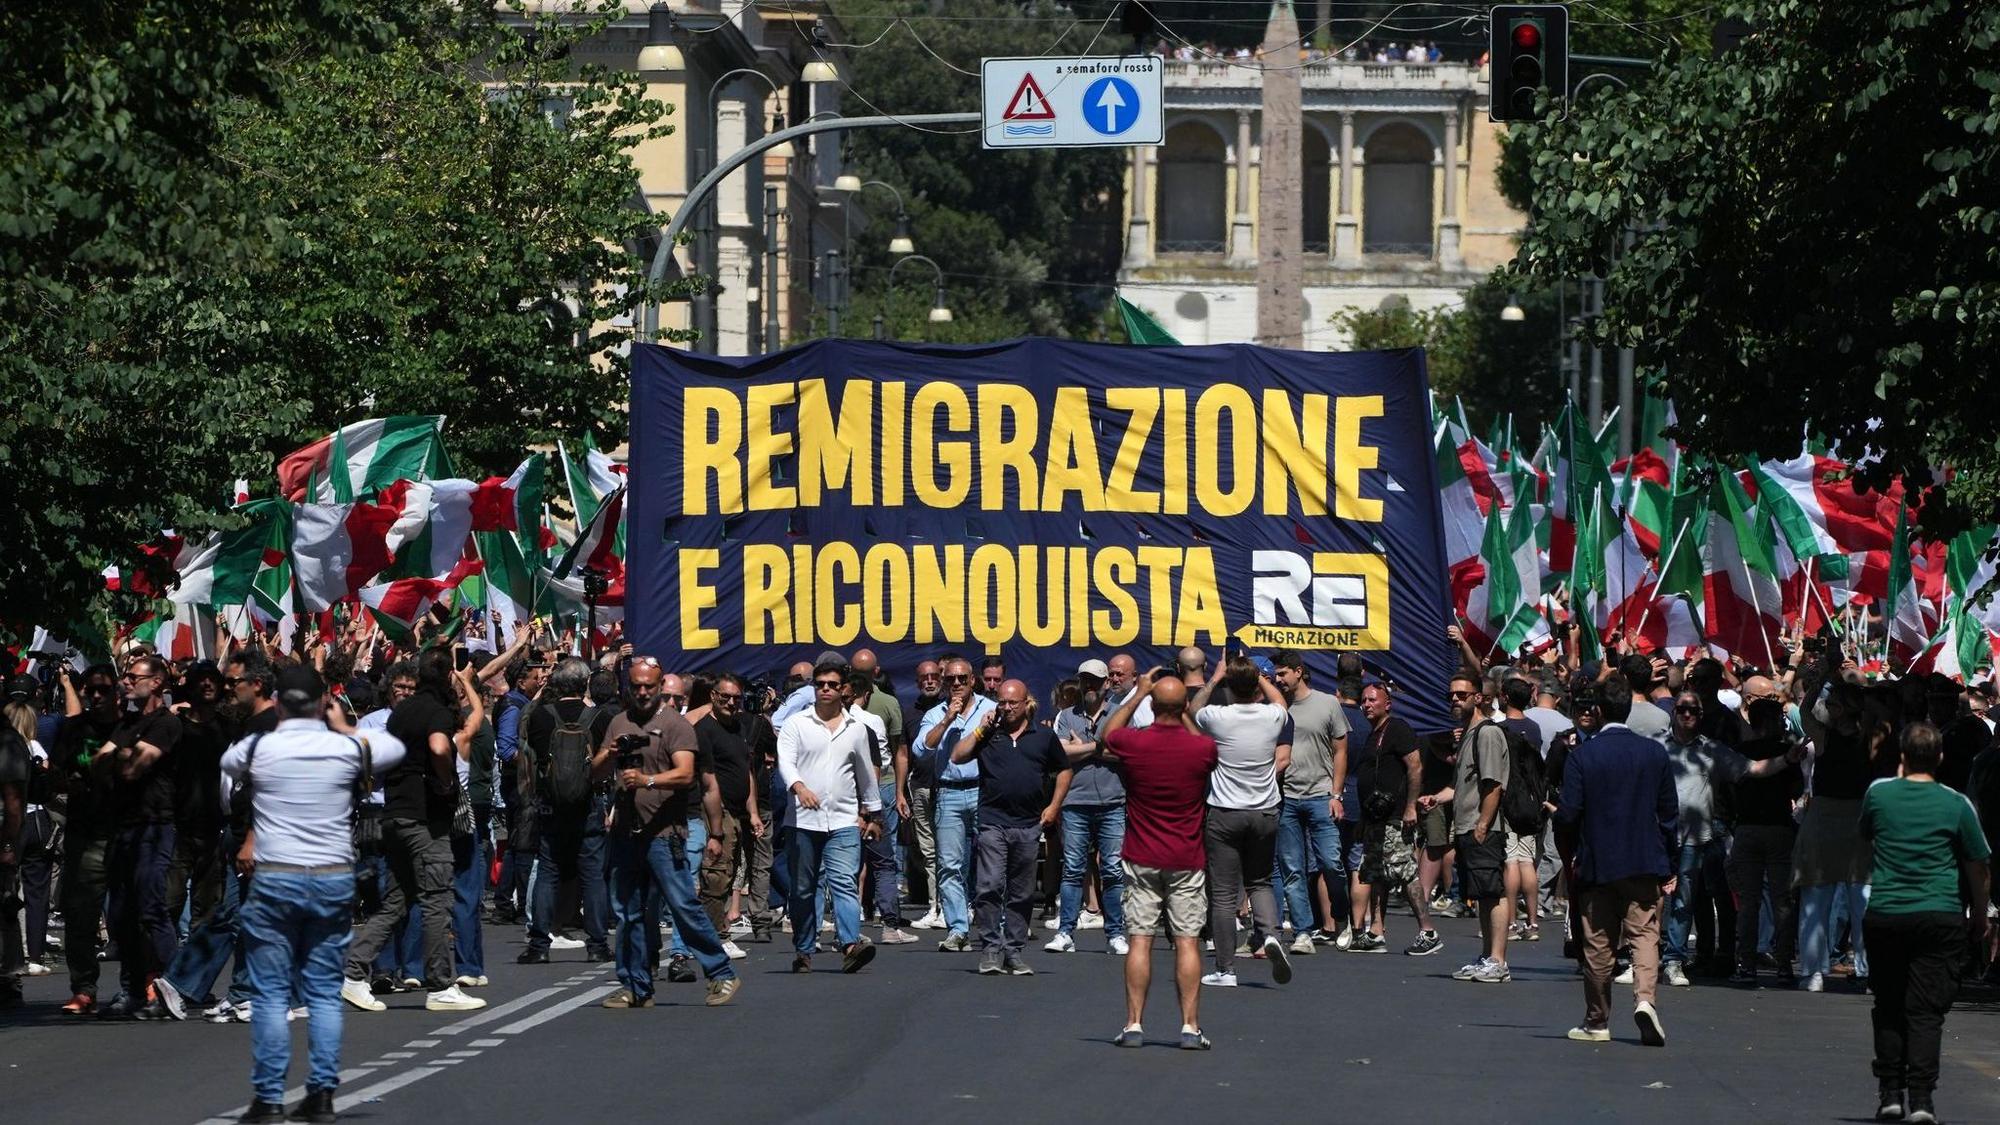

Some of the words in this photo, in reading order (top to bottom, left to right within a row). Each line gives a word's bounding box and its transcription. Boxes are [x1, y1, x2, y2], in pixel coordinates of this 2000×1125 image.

[1056, 66, 1062, 74] a
[1067, 63, 1119, 74] semaforo
[1124, 64, 1153, 73] rosso
[683, 378, 1385, 523] REMIGRAZIONE
[679, 547, 720, 651] E
[743, 541, 1228, 656] RICONQUISTA
[1252, 550, 1378, 626] RE
[1254, 629, 1360, 647] MIGRAZIONE
